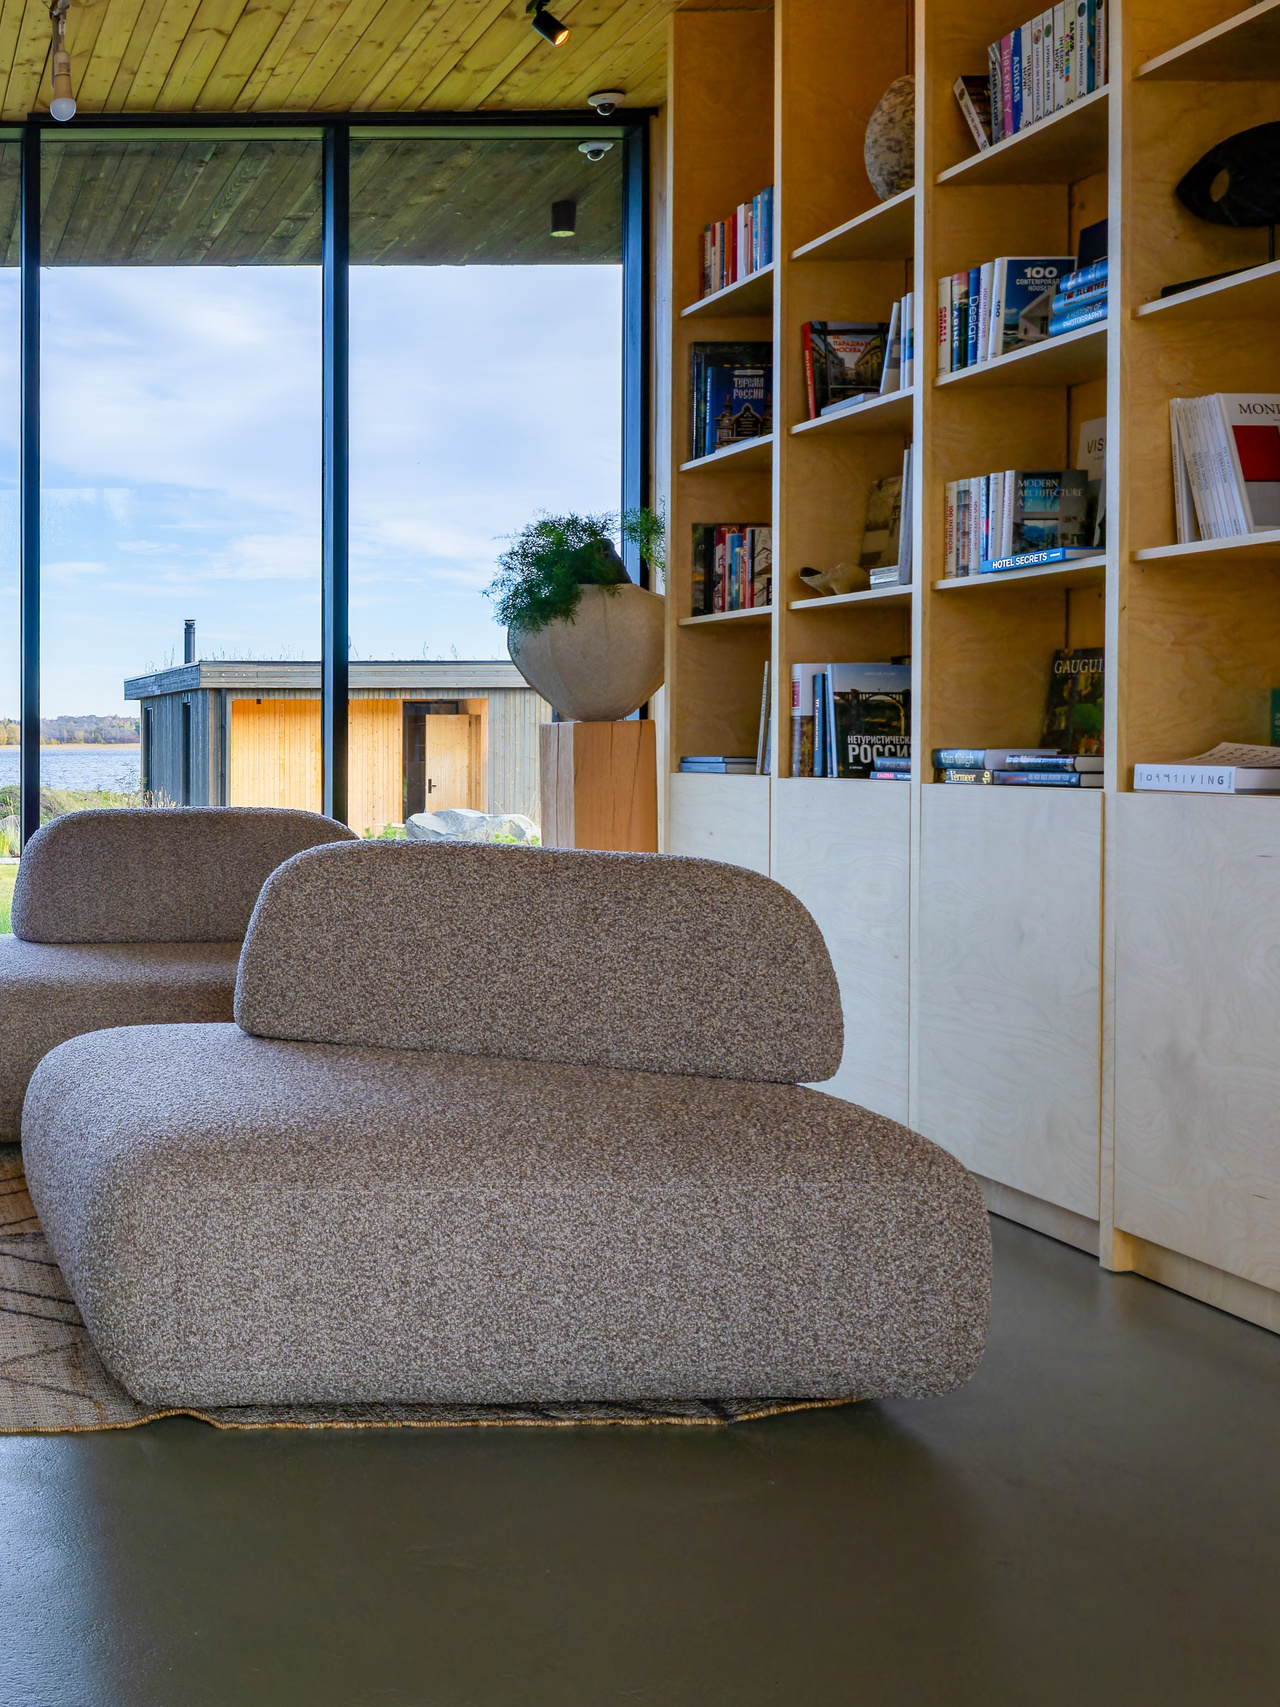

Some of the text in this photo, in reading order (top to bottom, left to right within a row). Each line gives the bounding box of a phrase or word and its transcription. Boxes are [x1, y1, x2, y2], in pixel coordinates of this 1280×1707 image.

[1003, 49, 1012, 113] HOCKNEY
[991, 59, 1000, 127] ZAHA HADID
[1023, 266, 1058, 278] 100
[1015, 278, 1061, 286] CONTEMPORAR
[1062, 309, 1104, 328] PHOTOGRAPHY
[1087, 437, 1104, 454] VIS
[1017, 478, 1059, 488] MODERN
[1016, 488, 1083, 497] ARCHITECTURE
[992, 552, 1048, 570] HOTEL SECRETS
[1054, 658, 1105, 674] GAUGUI
[847, 735, 911, 745] НЕТУРИСТИЧЕСК
[848, 744, 911, 763] РОССИ
[940, 752, 974, 767] Van Gogh
[949, 770, 976, 782] Vermeer
